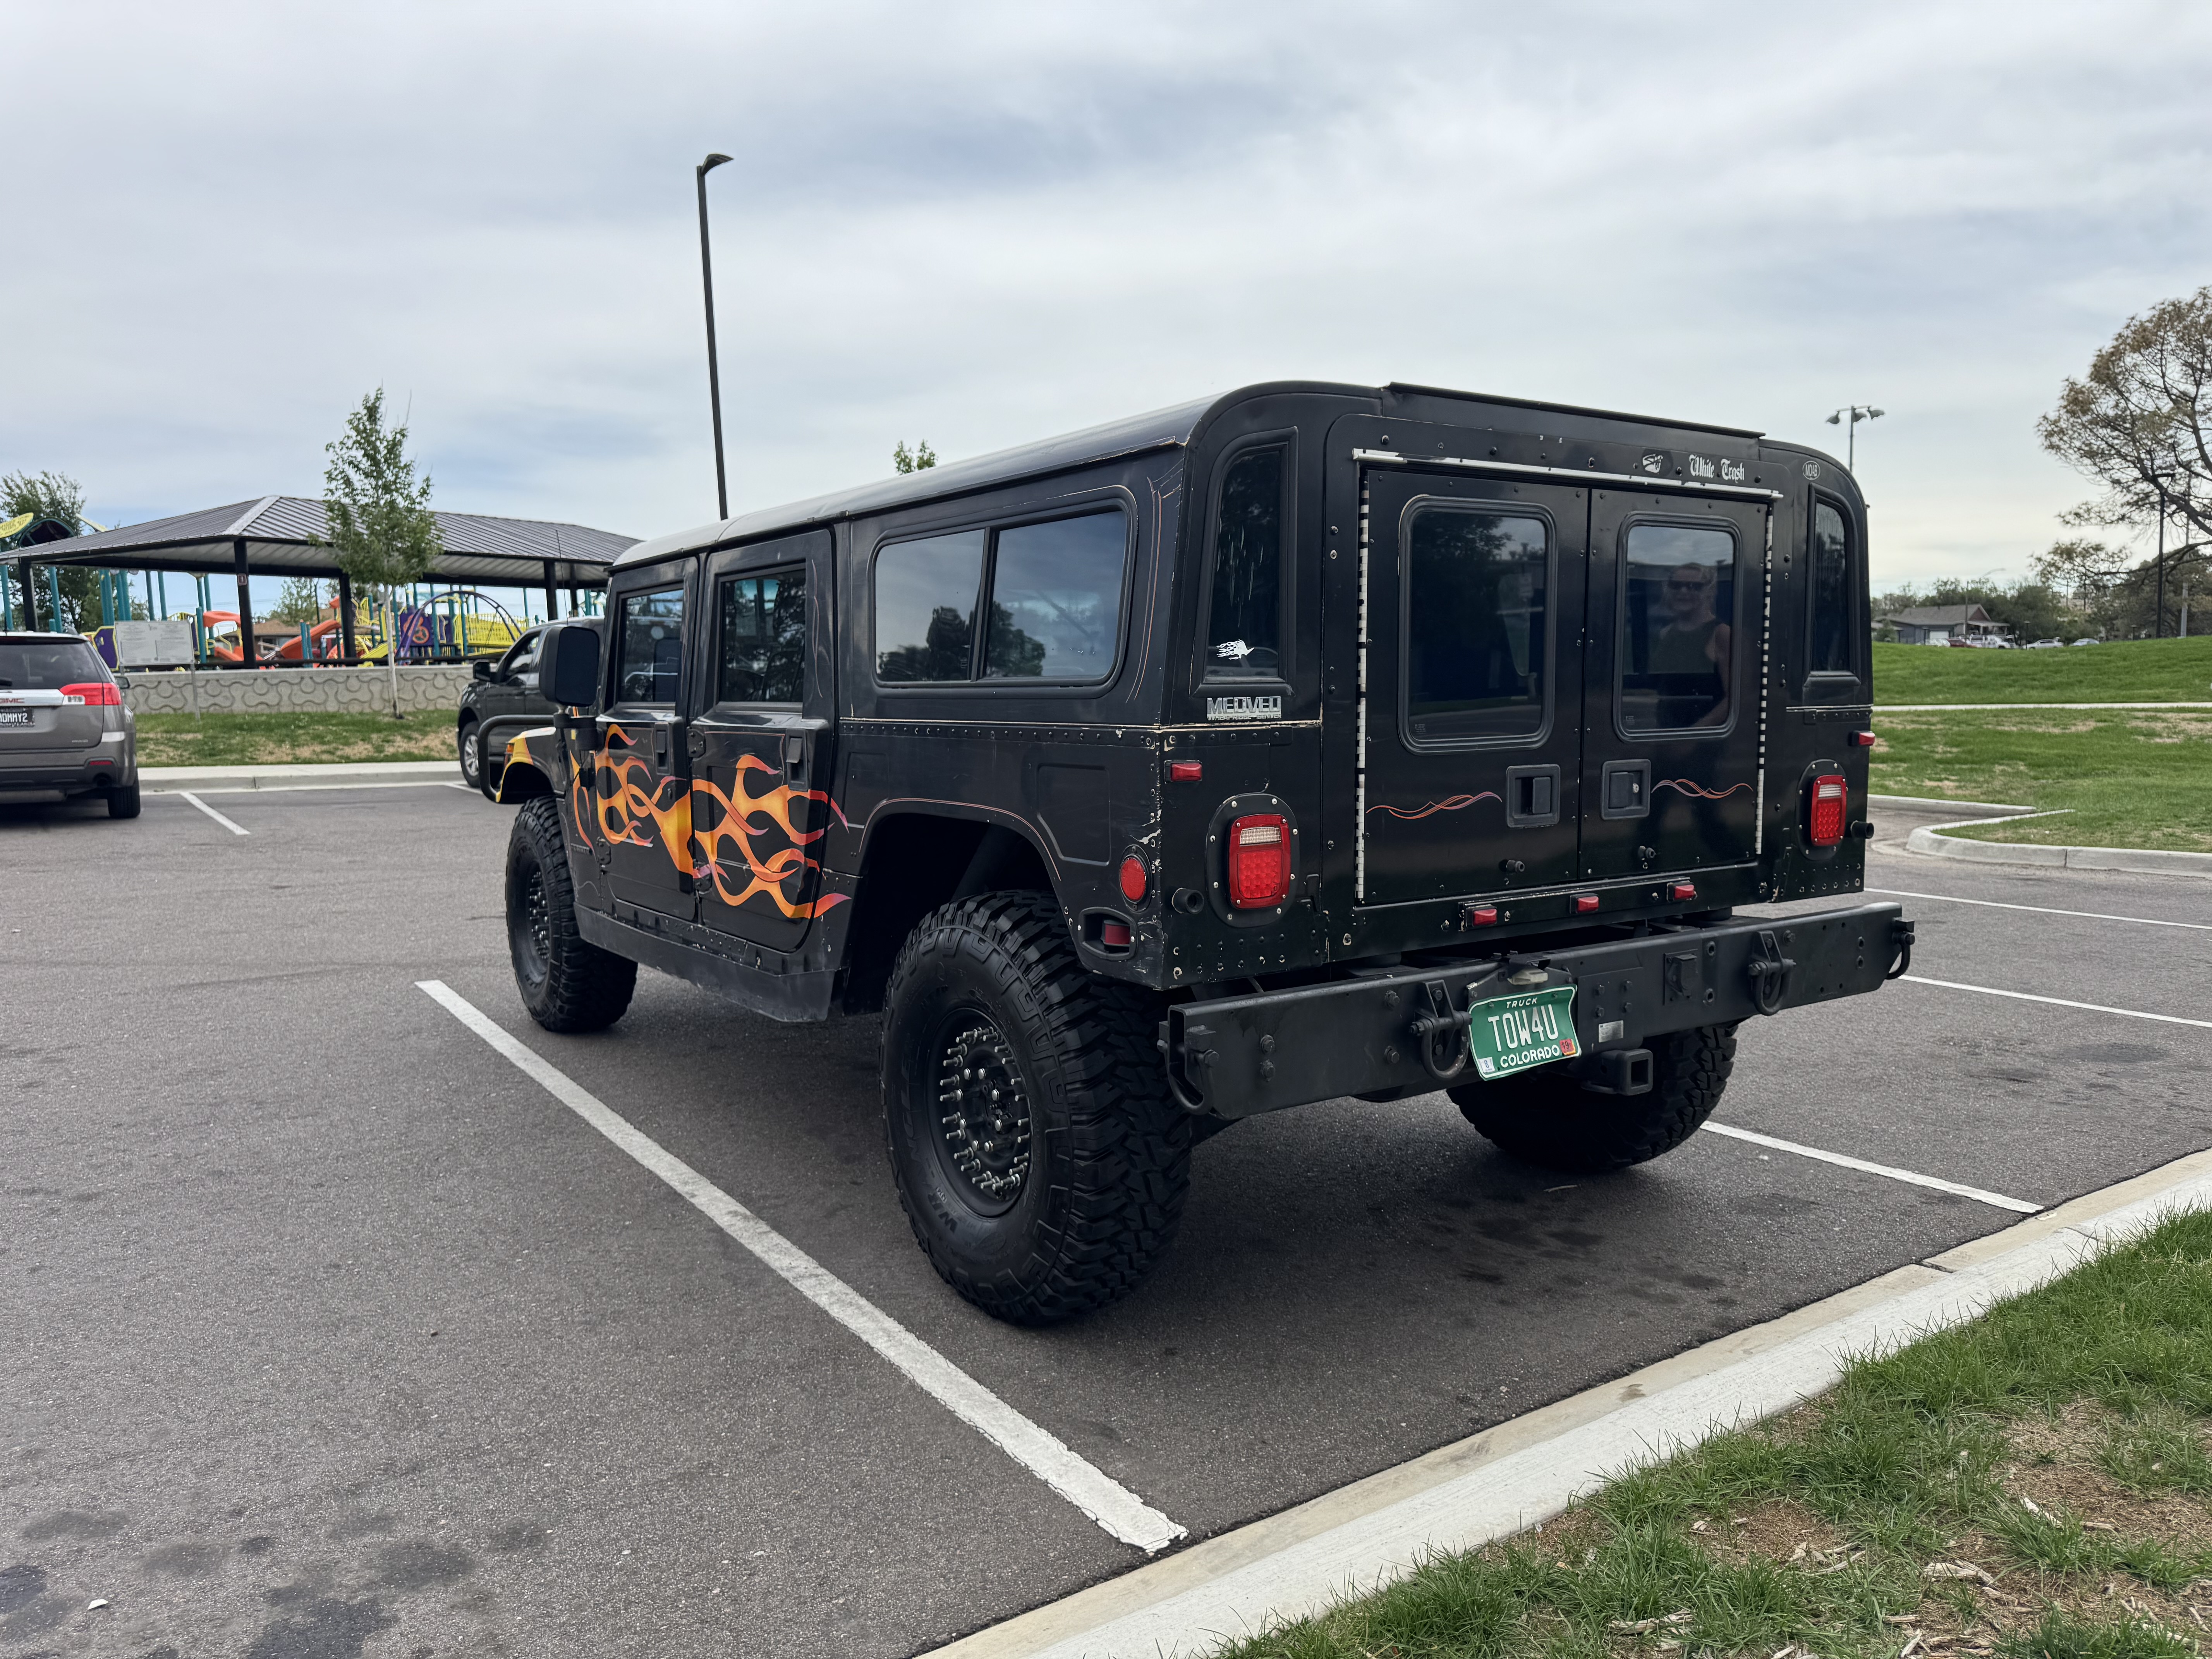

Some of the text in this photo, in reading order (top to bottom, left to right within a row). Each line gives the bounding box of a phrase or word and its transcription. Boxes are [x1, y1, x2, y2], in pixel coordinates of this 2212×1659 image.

[1689, 454, 1744, 483] White Trash
[1805, 464, 1817, 477] MOAB
[1207, 696, 1282, 714] MEDVED
[1506, 997, 1537, 1009] TRUCK
[1488, 1004, 1558, 1051] TOW4U
[1484, 1060, 1489, 1068] 8
[1500, 1044, 1560, 1068] COLORADO
